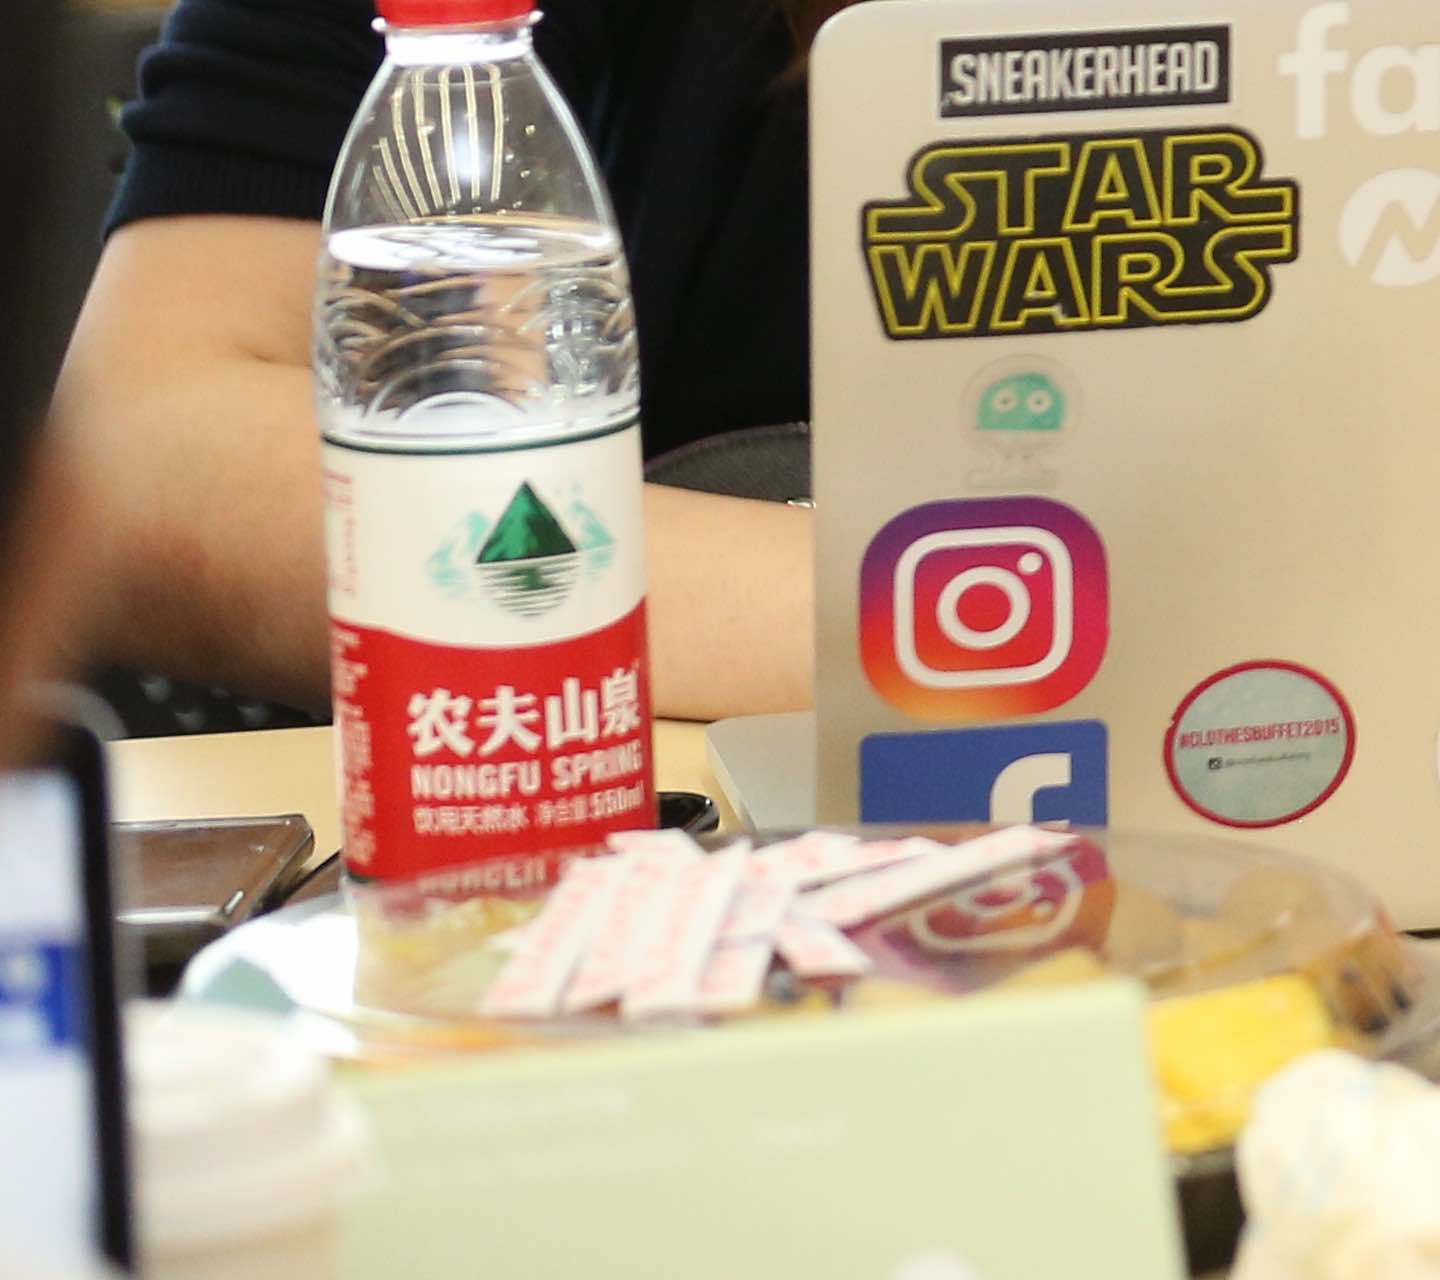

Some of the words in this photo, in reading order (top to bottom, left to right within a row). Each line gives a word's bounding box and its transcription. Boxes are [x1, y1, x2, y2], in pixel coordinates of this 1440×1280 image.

[949, 40, 1219, 105] SNEAKERHEAD
[866, 132, 1293, 240] STAR
[867, 223, 1293, 331] WARS
[407, 667, 641, 757] 农夫山泉
[411, 759, 542, 800] NONGFU
[551, 740, 642, 791] SPRING
